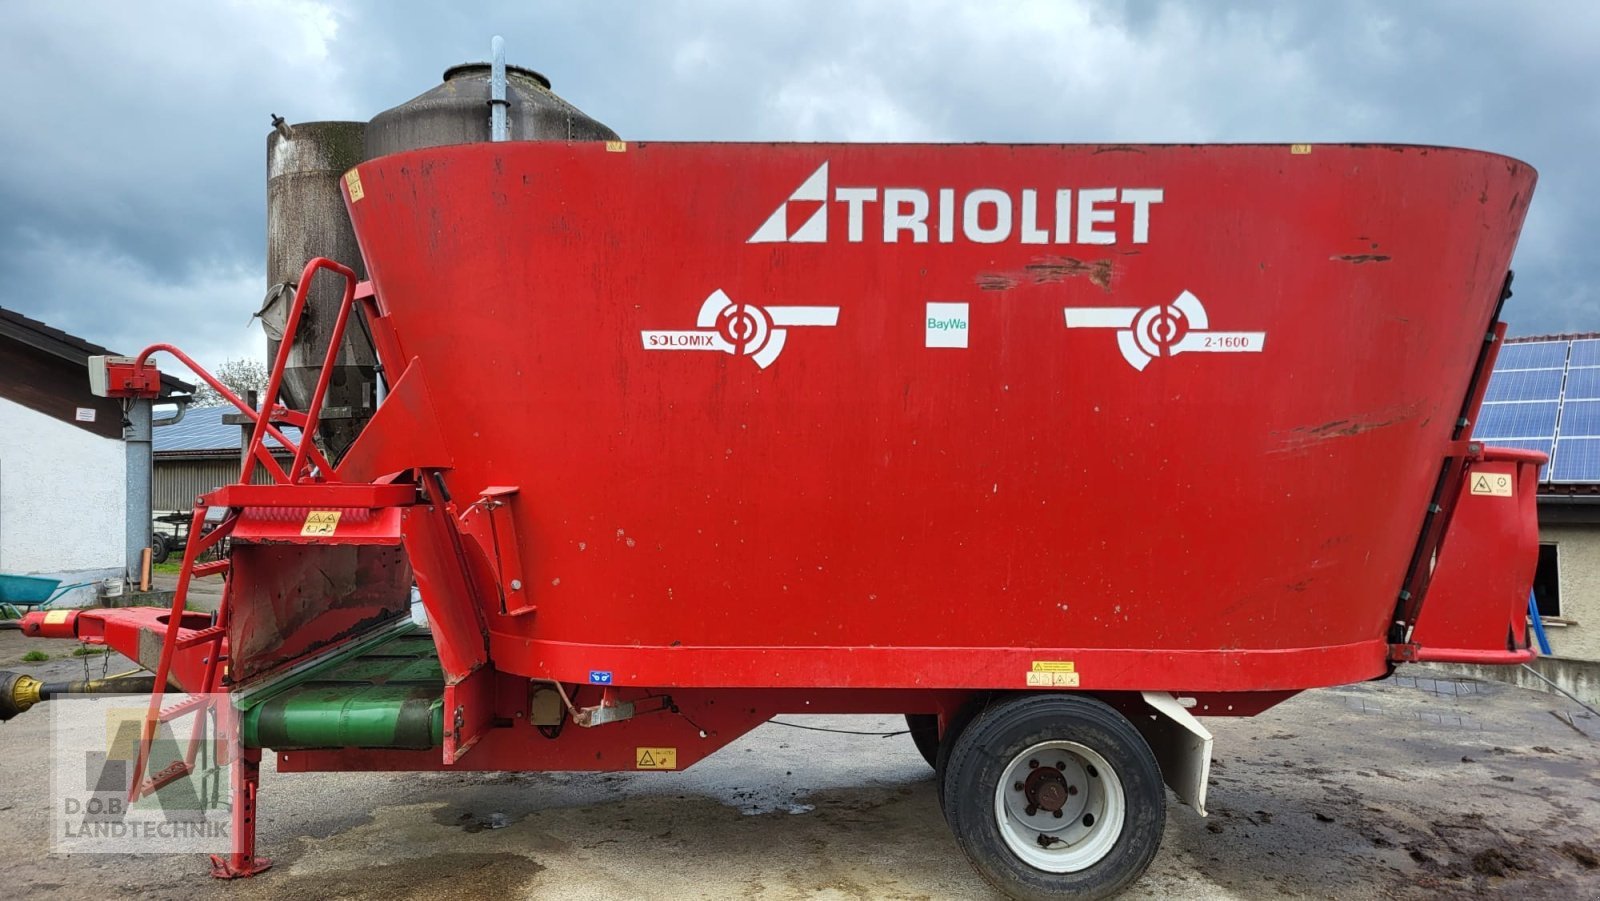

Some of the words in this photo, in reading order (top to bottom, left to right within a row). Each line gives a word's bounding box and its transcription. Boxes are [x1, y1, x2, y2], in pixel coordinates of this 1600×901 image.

[835, 187, 1164, 245] TRIOLIET
[928, 318, 967, 331] BayWa
[649, 335, 714, 346] SOLOMIX
[1204, 336, 1249, 348] 2-1600
